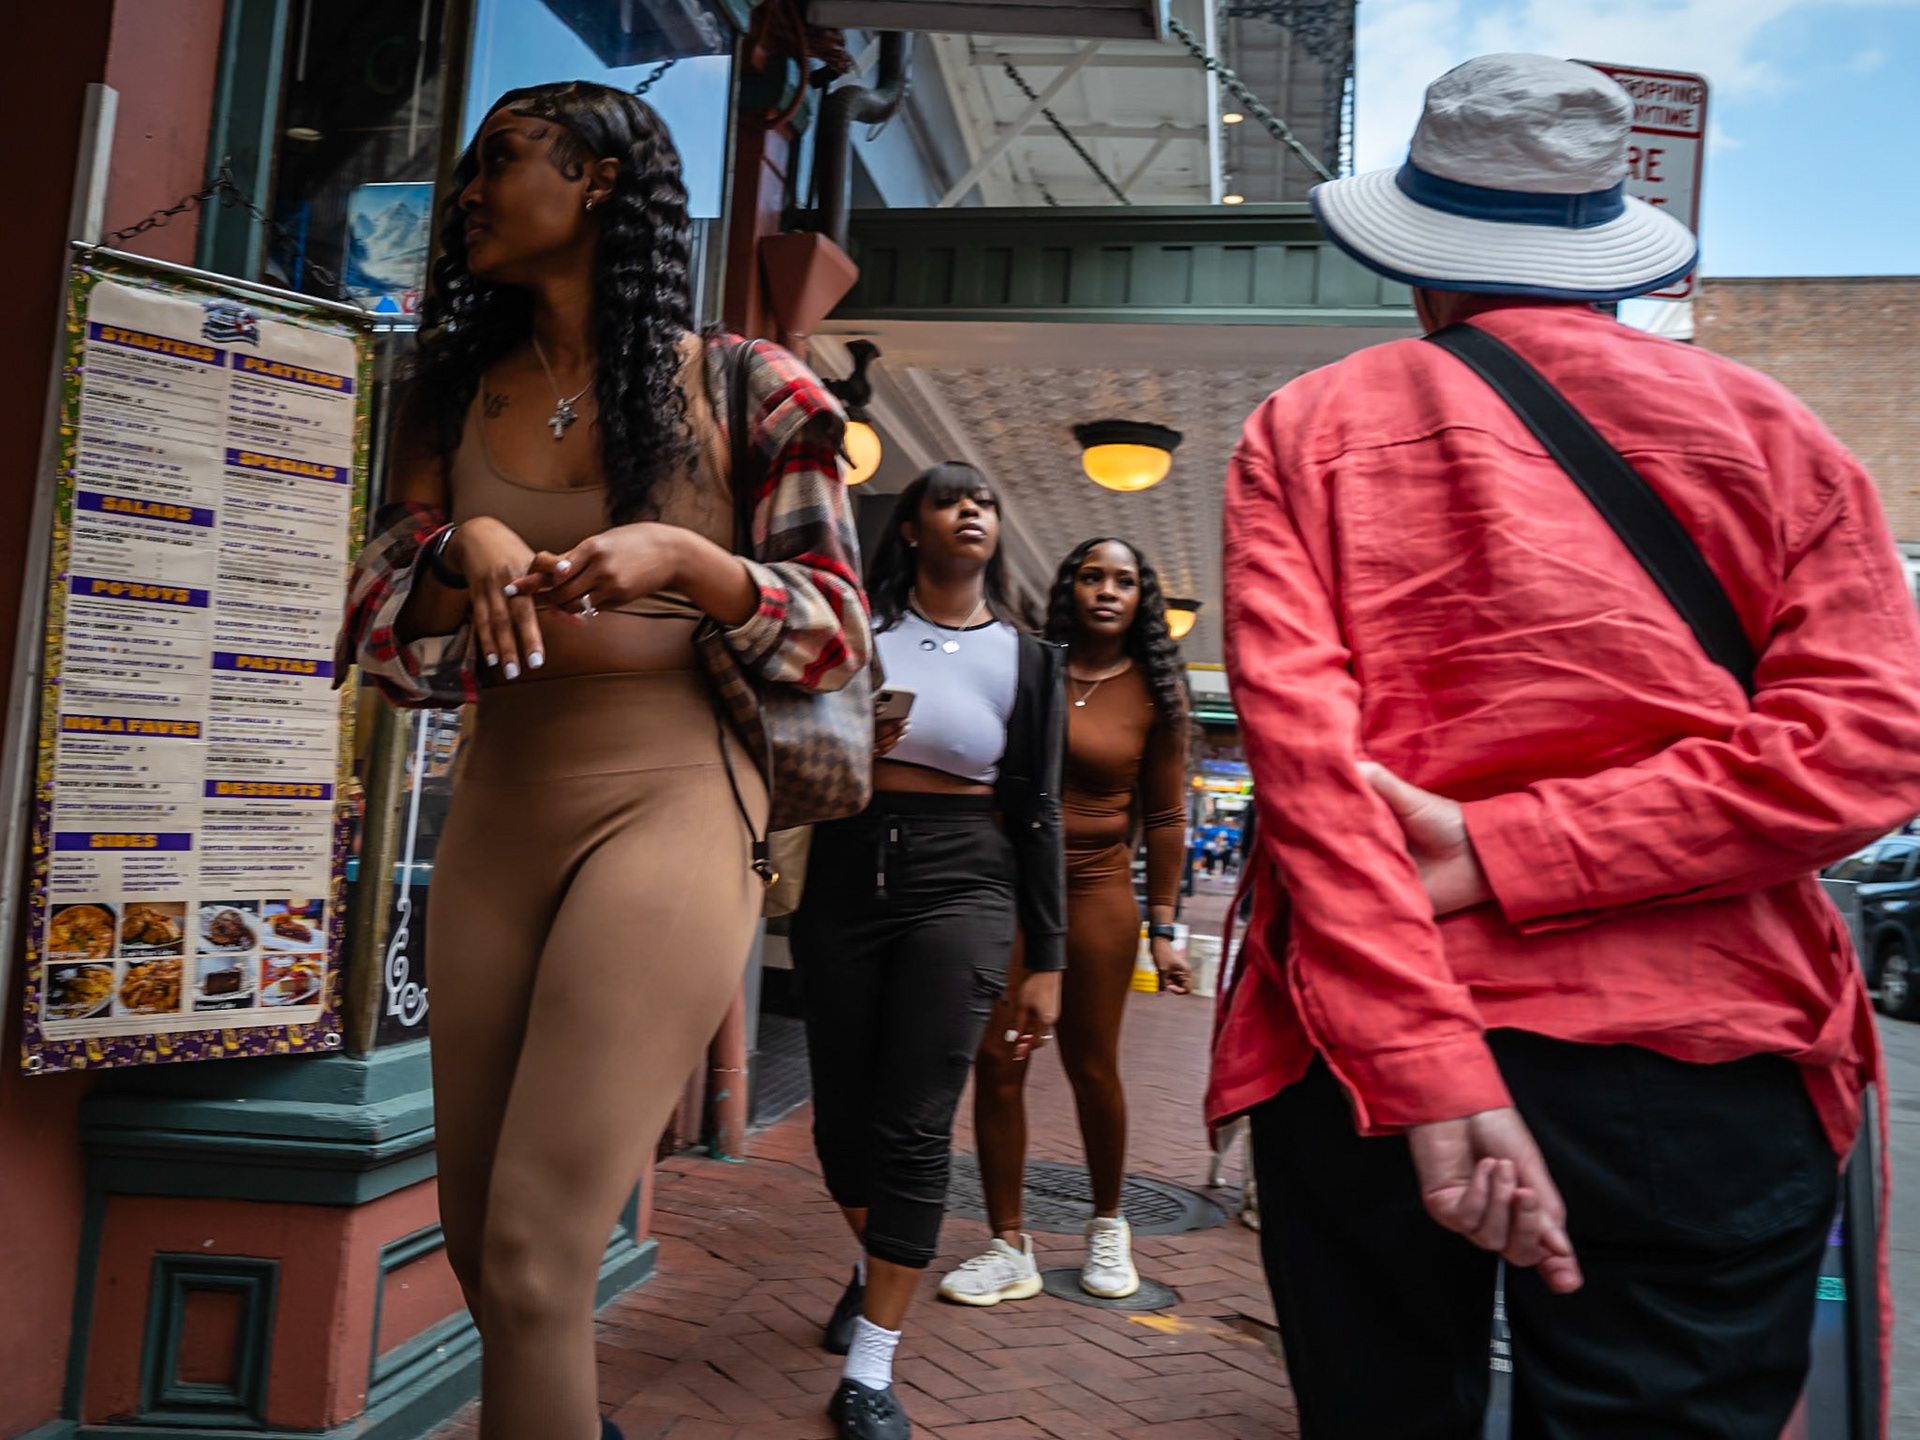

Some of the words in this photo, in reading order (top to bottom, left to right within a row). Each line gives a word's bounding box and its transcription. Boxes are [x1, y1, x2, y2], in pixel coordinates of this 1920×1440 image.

[1633, 104, 1694, 127] NYTIME
[1625, 146, 1667, 182] RE
[101, 326, 214, 361] STARTERS
[244, 357, 342, 388] PLATTERS
[240, 452, 335, 479] SPECIALS
[102, 496, 191, 521] SALADS
[92, 580, 189, 603] PO'BOYS
[236, 655, 317, 674] PASTAS
[63, 716, 124, 732] NOLA
[127, 719, 200, 736] FAVES
[216, 781, 322, 798] DESSERTS
[90, 833, 157, 848] SIDES
